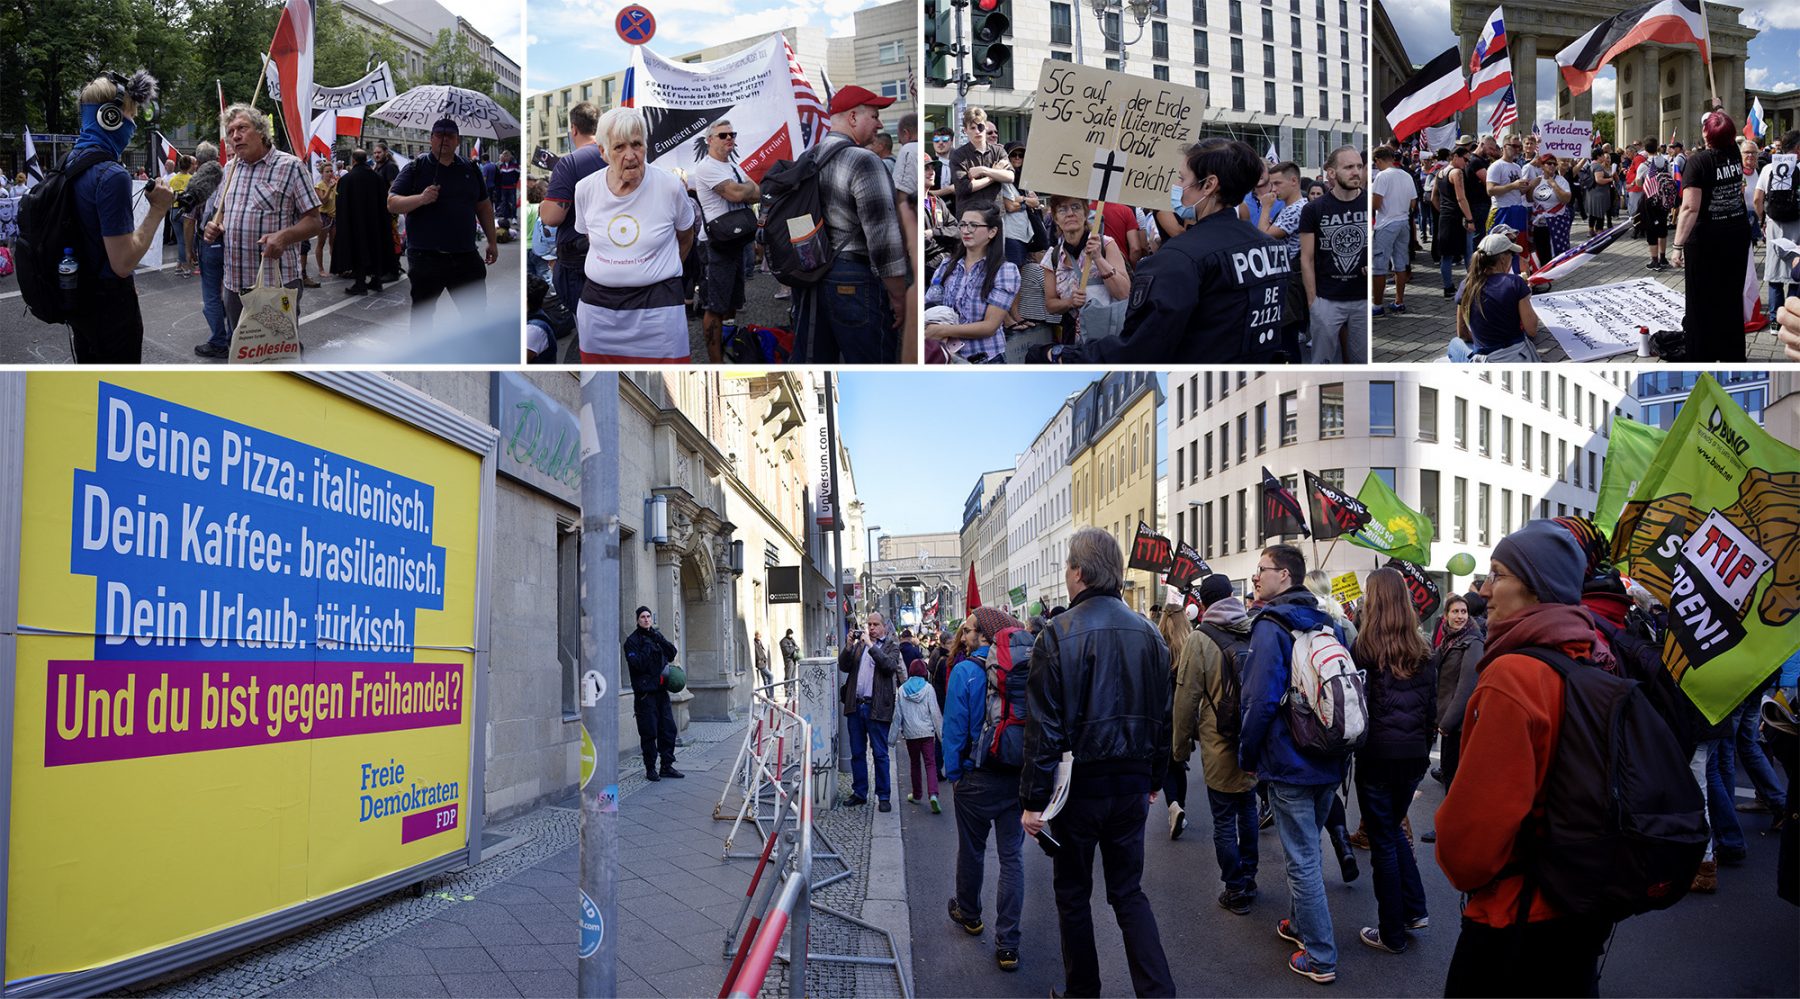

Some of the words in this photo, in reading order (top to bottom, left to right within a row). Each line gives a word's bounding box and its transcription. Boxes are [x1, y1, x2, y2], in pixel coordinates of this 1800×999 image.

[1044, 68, 1076, 96] 5G
[1083, 80, 1112, 105] auf
[1127, 89, 1153, 112] der
[1155, 90, 1191, 120] Erde
[1085, 125, 1105, 145] im
[1119, 131, 1161, 158] Orbit
[1545, 139, 1582, 156] vertrag
[1053, 153, 1082, 177] Es
[1125, 165, 1176, 193] reicht
[1232, 245, 1291, 284] POLZEI
[1264, 286, 1279, 305] BE
[237, 341, 298, 360] Schlesien
[1720, 419, 1750, 456] BUND
[107, 396, 211, 481] Deine
[220, 429, 305, 504] Pizza:
[312, 457, 430, 534] italienisch.
[819, 426, 830, 512] universum.com
[82, 484, 169, 559] Dein
[180, 502, 292, 576] Kaffee:
[300, 526, 441, 595] brasilianisch.
[1697, 525, 1757, 588] TTIP
[105, 580, 188, 647] Dein
[200, 589, 306, 649] Urlaub:
[314, 602, 411, 653] türkisch.
[56, 672, 136, 741] Und
[146, 672, 191, 734] du
[200, 671, 260, 731] bist
[266, 680, 344, 738] gegen
[350, 670, 461, 718] Freihandel?
[361, 758, 405, 790] Freie
[359, 782, 459, 822] Demokraten
[436, 808, 456, 828] FDP
